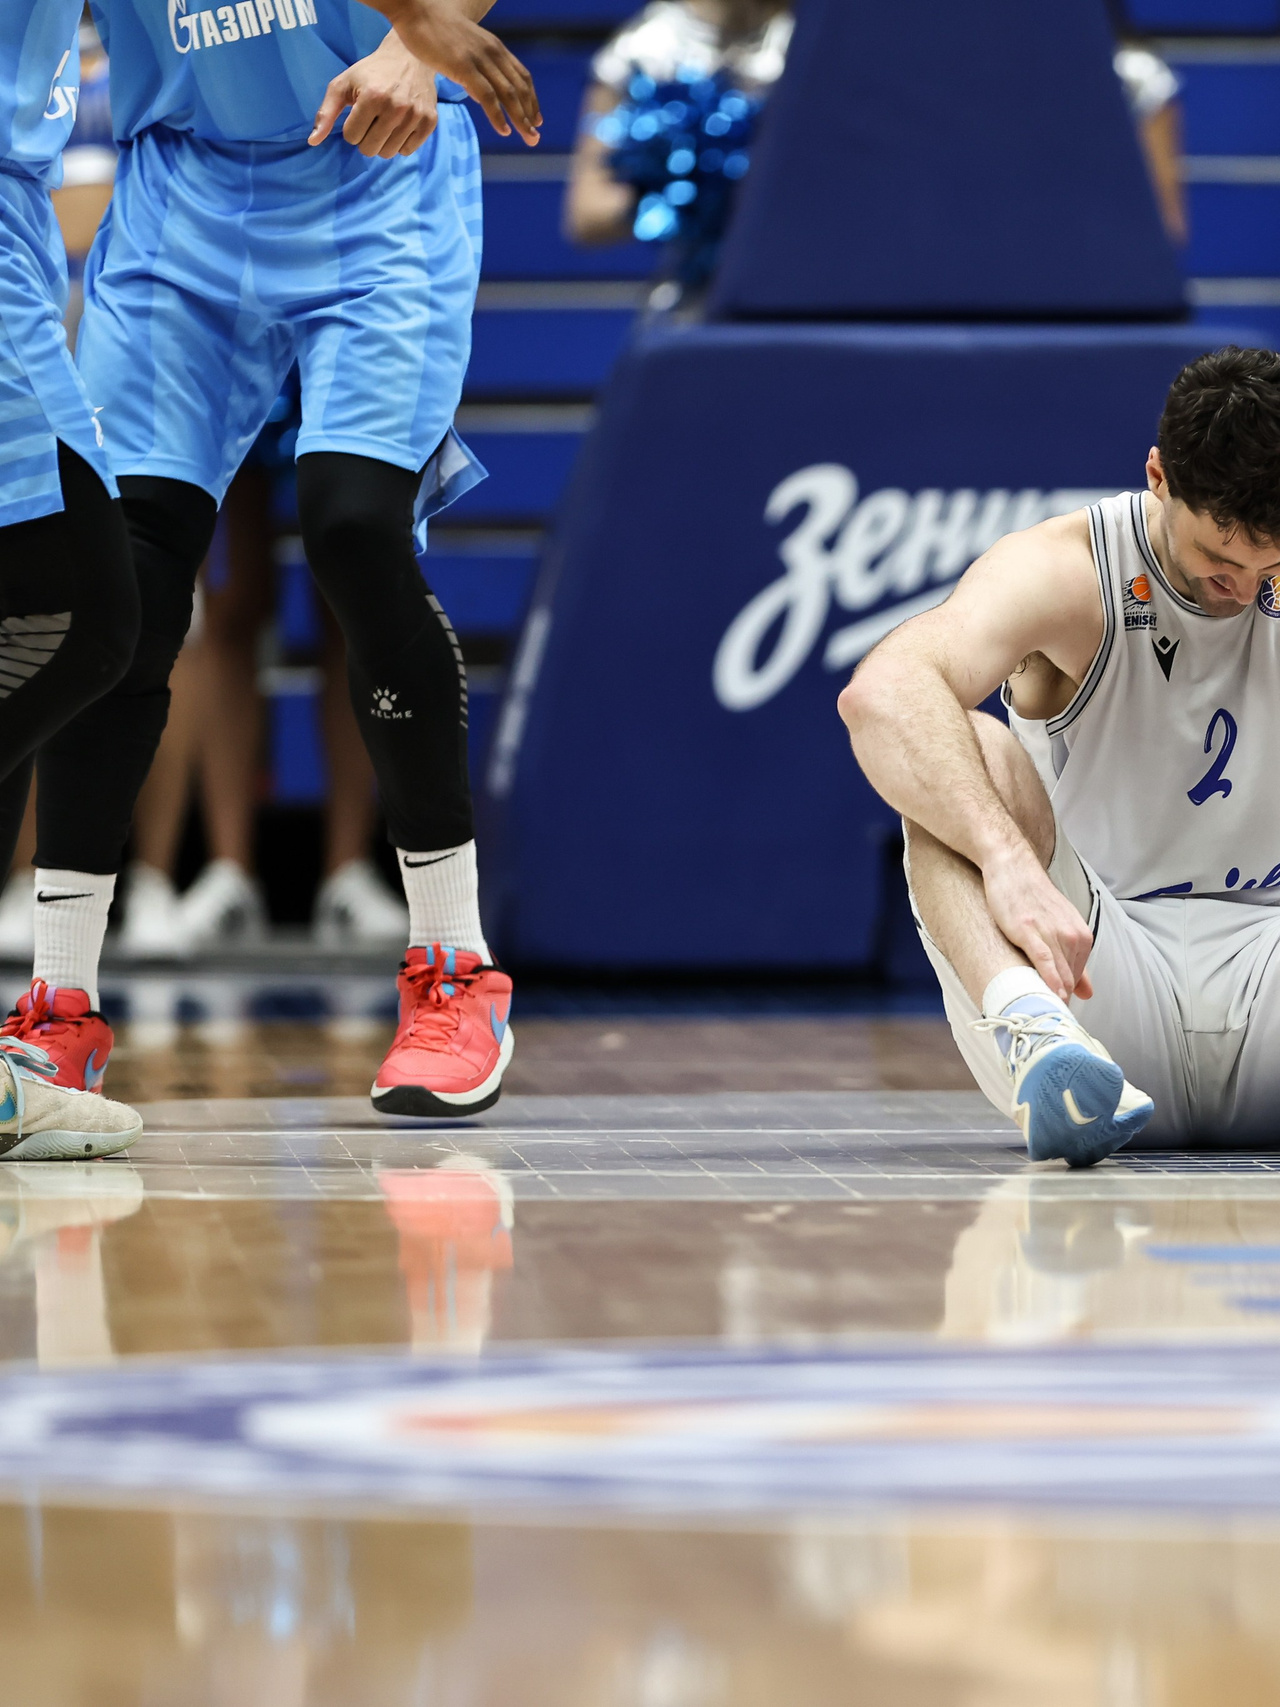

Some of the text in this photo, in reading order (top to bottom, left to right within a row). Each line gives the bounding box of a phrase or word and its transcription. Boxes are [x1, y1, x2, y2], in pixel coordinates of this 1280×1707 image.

[712, 462, 1145, 712] Зени
[370, 708, 413, 719] KELME
[1186, 707, 1238, 807] 2
